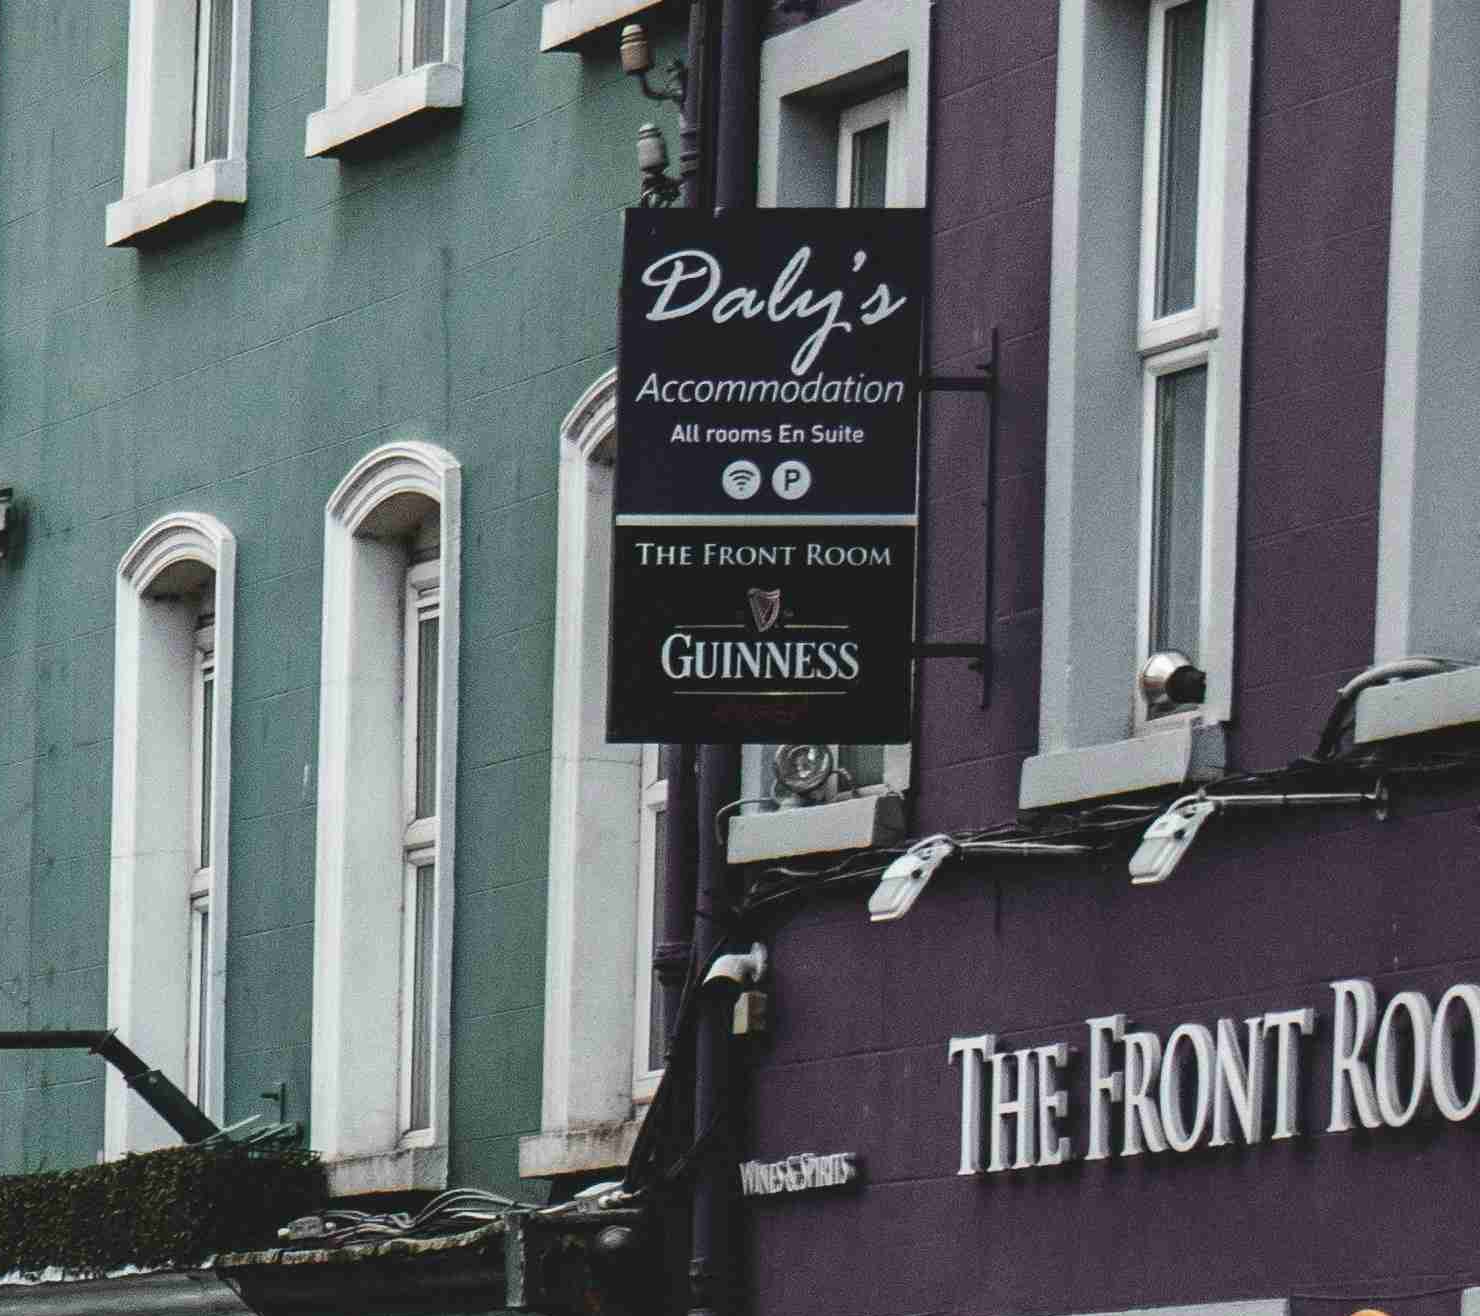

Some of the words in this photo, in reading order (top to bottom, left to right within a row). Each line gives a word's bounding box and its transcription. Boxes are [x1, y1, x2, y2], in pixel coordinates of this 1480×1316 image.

[641, 246, 907, 376] Daly's
[635, 371, 905, 403] Accommodation
[670, 424, 699, 443] All
[706, 428, 772, 443] rooms
[779, 424, 804, 443] En
[810, 424, 865, 443] Suite
[635, 542, 693, 566] THE
[703, 542, 796, 566] FRONT
[806, 542, 892, 566] ROOM
[660, 632, 860, 680] GUINNESS
[948, 1034, 1071, 1177] THE
[1084, 1008, 1316, 1162] FRONT
